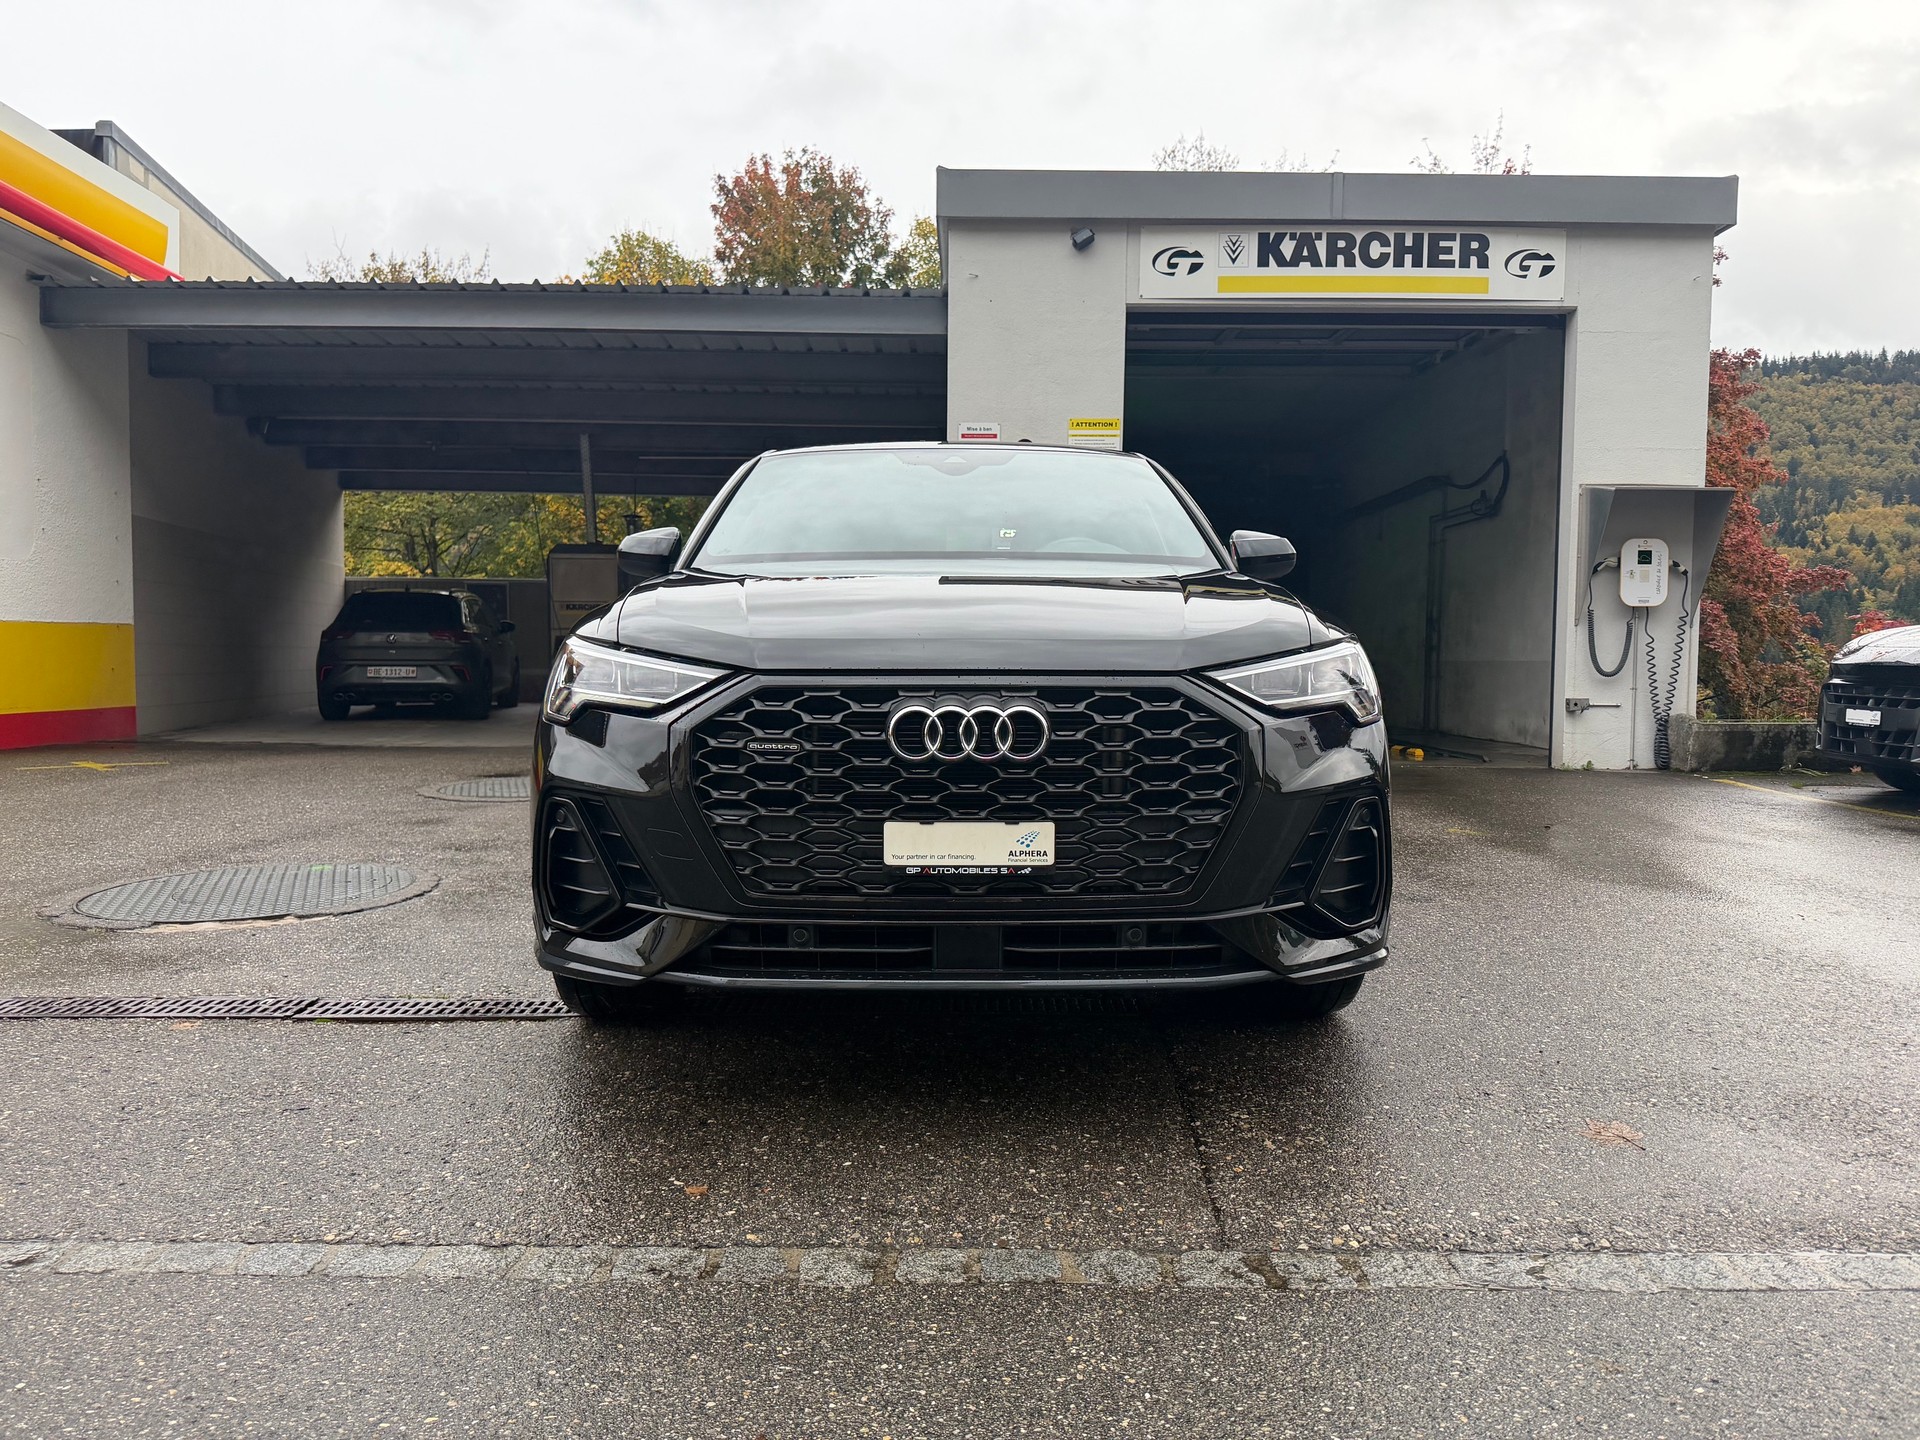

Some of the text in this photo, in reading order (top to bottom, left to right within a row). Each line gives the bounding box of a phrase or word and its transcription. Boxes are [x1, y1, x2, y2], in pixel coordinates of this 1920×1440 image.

[1256, 231, 1490, 269] KÄRCHER
[906, 853, 929, 861] partner
[947, 853, 976, 861] financing.
